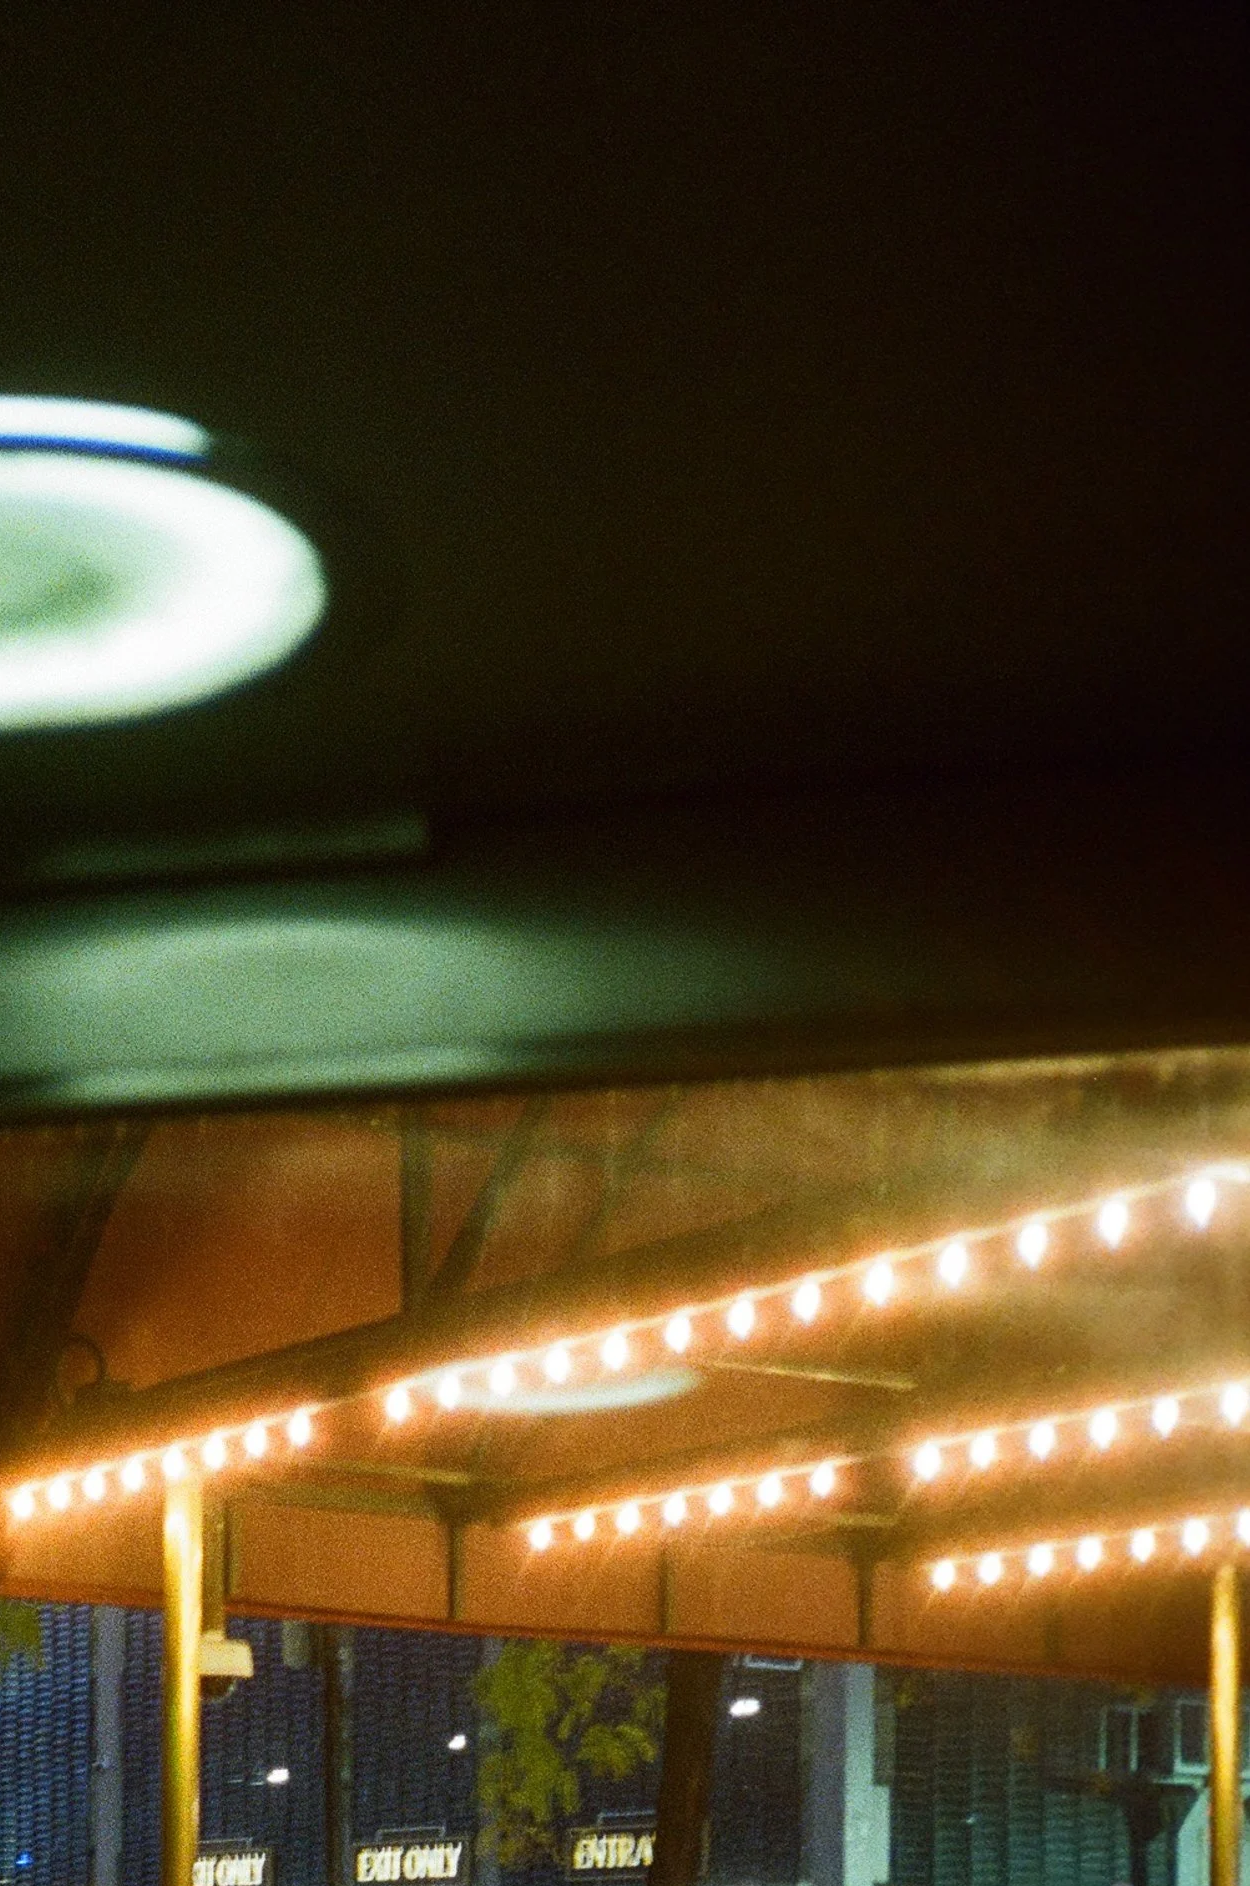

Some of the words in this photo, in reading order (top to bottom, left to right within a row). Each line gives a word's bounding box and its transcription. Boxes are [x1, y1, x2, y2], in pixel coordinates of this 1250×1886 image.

[356, 1846, 403, 1882] EXIT
[402, 1842, 462, 1880] ONLY
[573, 1831, 656, 1869] ENTRA
[215, 1853, 266, 1886] ONLY
